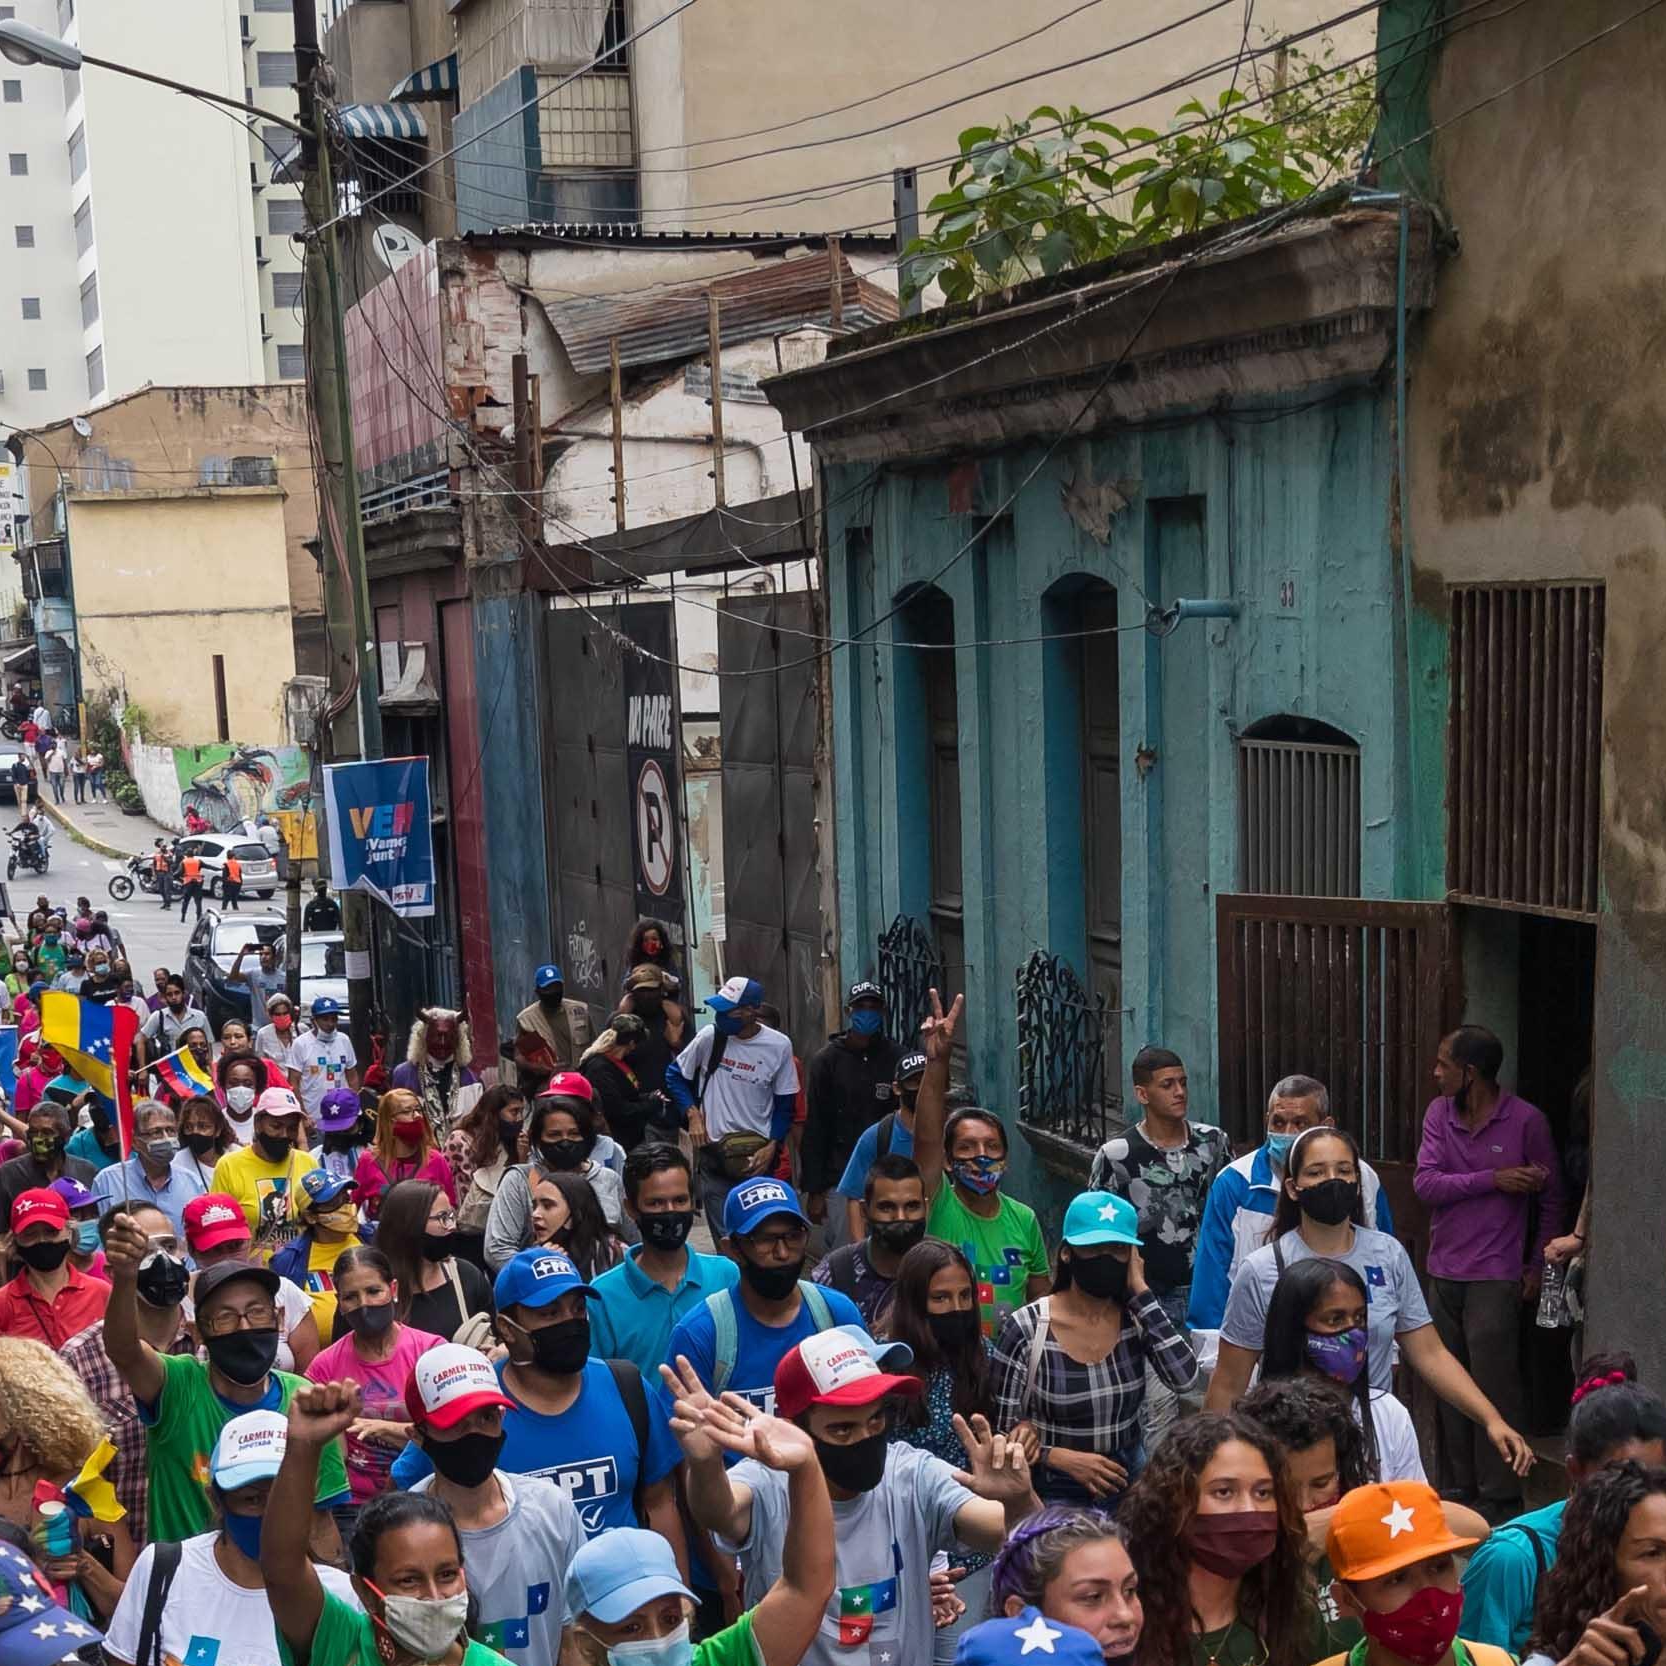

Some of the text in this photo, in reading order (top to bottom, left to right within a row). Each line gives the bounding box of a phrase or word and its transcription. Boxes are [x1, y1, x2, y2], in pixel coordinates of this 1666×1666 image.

[629, 694, 672, 750] NO PARE
[349, 802, 413, 839] VEN
[851, 982, 883, 996] CUPAZ
[902, 1055, 926, 1070] CUP
[826, 1350, 856, 1368] CARMEN
[433, 1364, 467, 1384] CARMEN
[238, 1430, 274, 1444] CARMEN
[238, 1440, 271, 1450] DIPUTADA
[550, 1465, 610, 1500] PT
